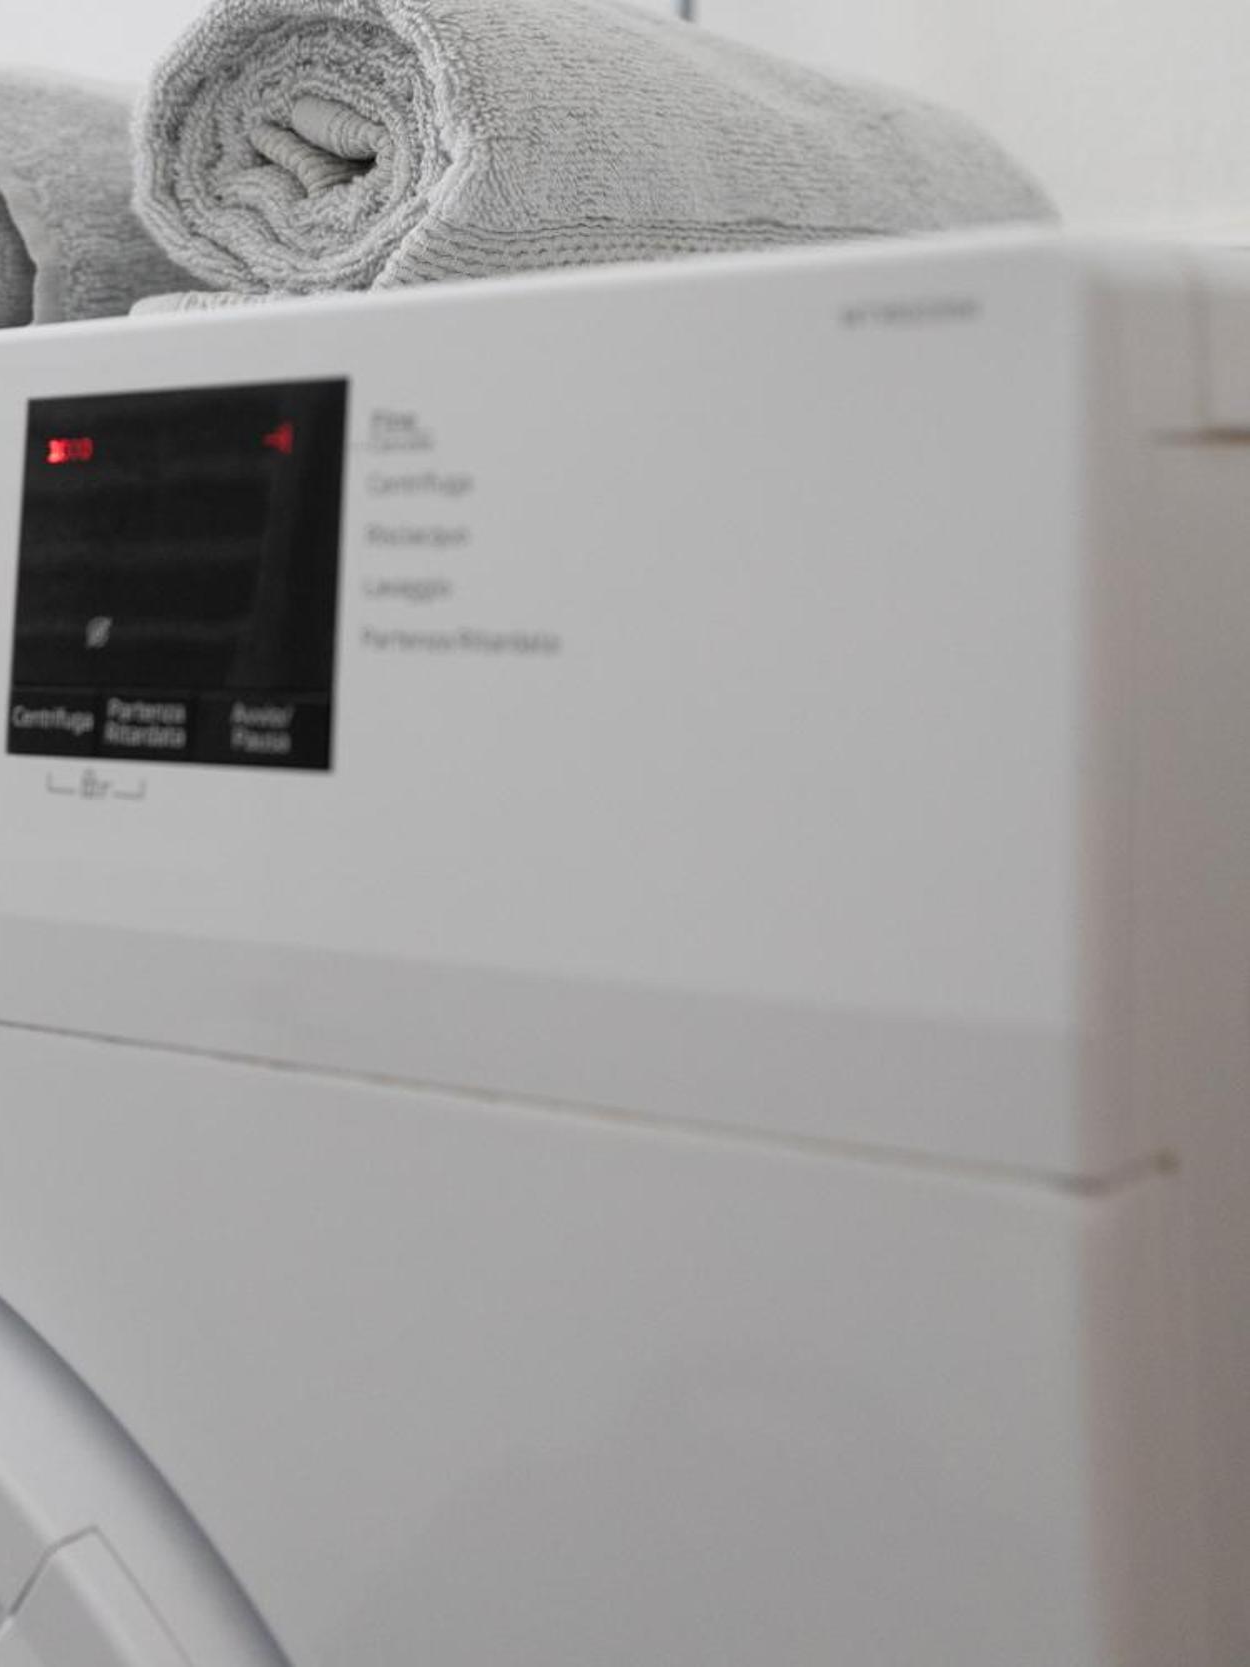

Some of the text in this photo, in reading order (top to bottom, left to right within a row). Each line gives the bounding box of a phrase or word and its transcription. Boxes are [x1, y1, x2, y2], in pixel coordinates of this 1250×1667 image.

[12, 705, 95, 736] Centrifuga
[106, 697, 187, 725] Partenza
[105, 720, 187, 749] Ritardata
